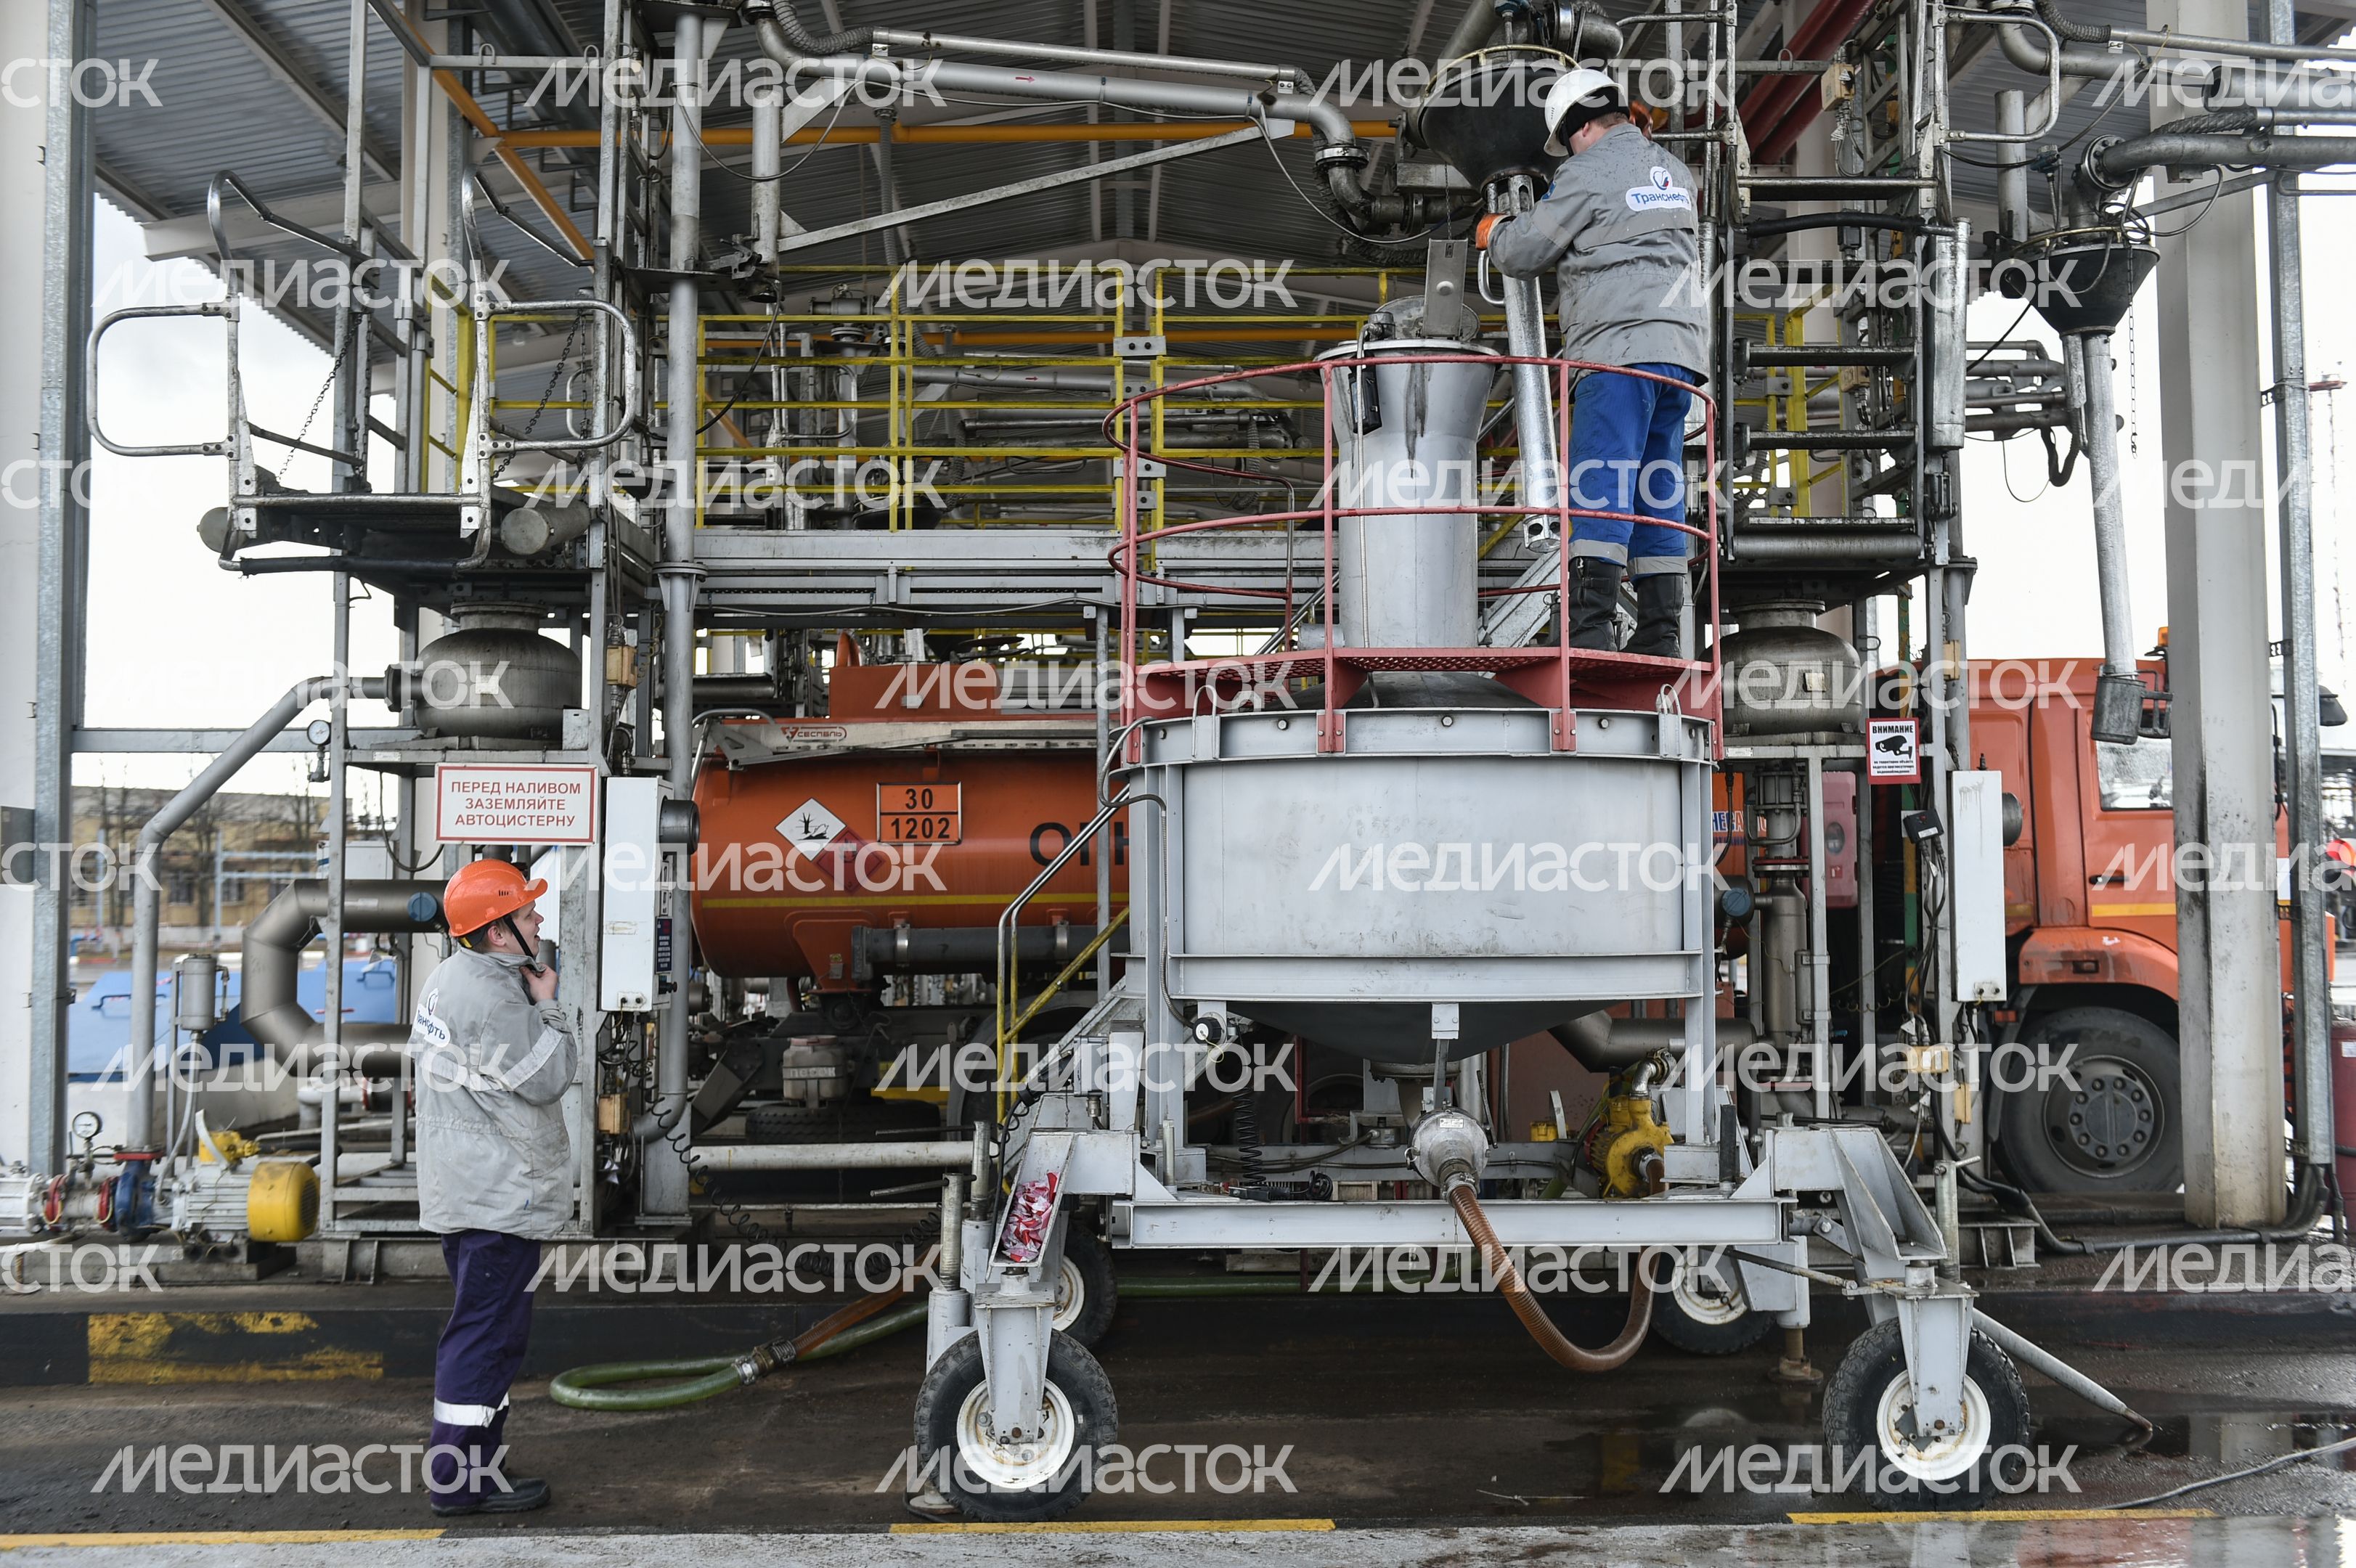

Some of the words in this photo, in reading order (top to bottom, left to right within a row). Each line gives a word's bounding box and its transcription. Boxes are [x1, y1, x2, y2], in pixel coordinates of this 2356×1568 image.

[1872, 725, 1915, 734] ВНИМАНИЕ
[451, 781, 501, 795] ПЕРЕД
[505, 782, 581, 794] НАЛИВОМ
[465, 796, 566, 810] ЗАЗЕМЛЯЙТЕ
[905, 788, 934, 810] 30
[455, 814, 576, 828] АВТОЦИСТЕРНУ
[890, 817, 950, 840] 1202
